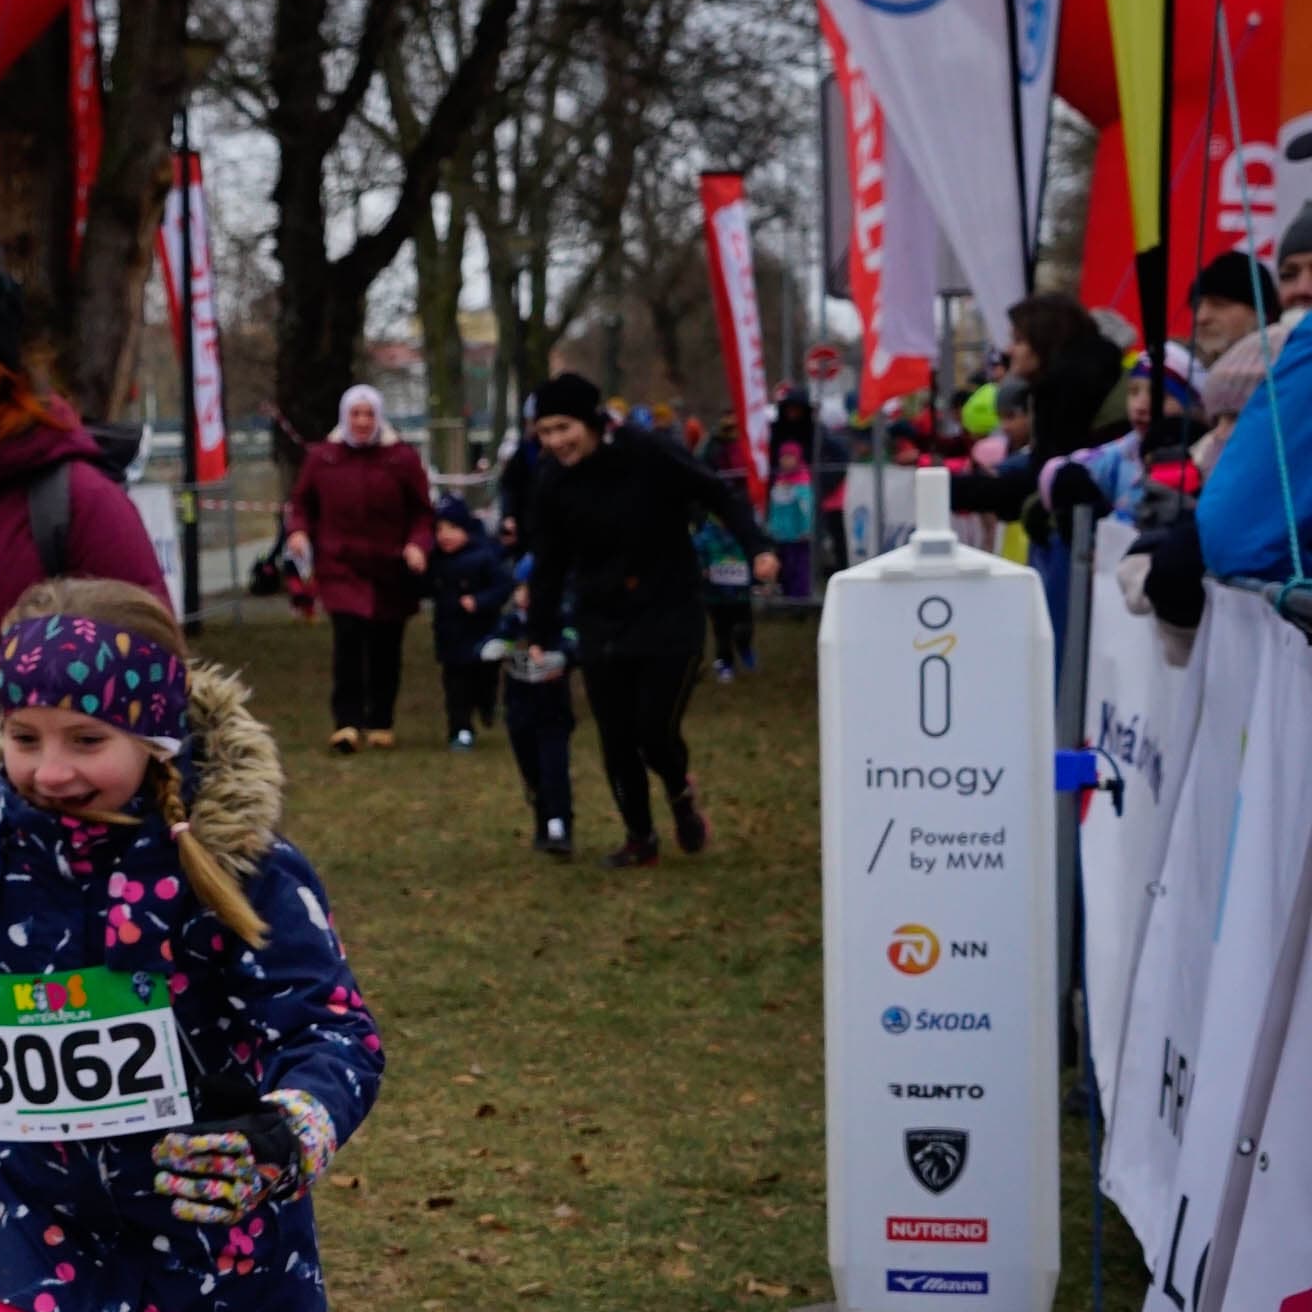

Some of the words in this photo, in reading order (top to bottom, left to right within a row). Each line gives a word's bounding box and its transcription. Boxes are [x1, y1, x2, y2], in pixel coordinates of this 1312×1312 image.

[866, 758, 1005, 796] innogy
[910, 825, 1006, 846] Powered
[910, 851, 937, 875] by
[946, 852, 1005, 870] MVM
[950, 941, 988, 958] NN
[915, 1008, 992, 1031] ŠKODA
[891, 1221, 985, 1238] NUTREND
